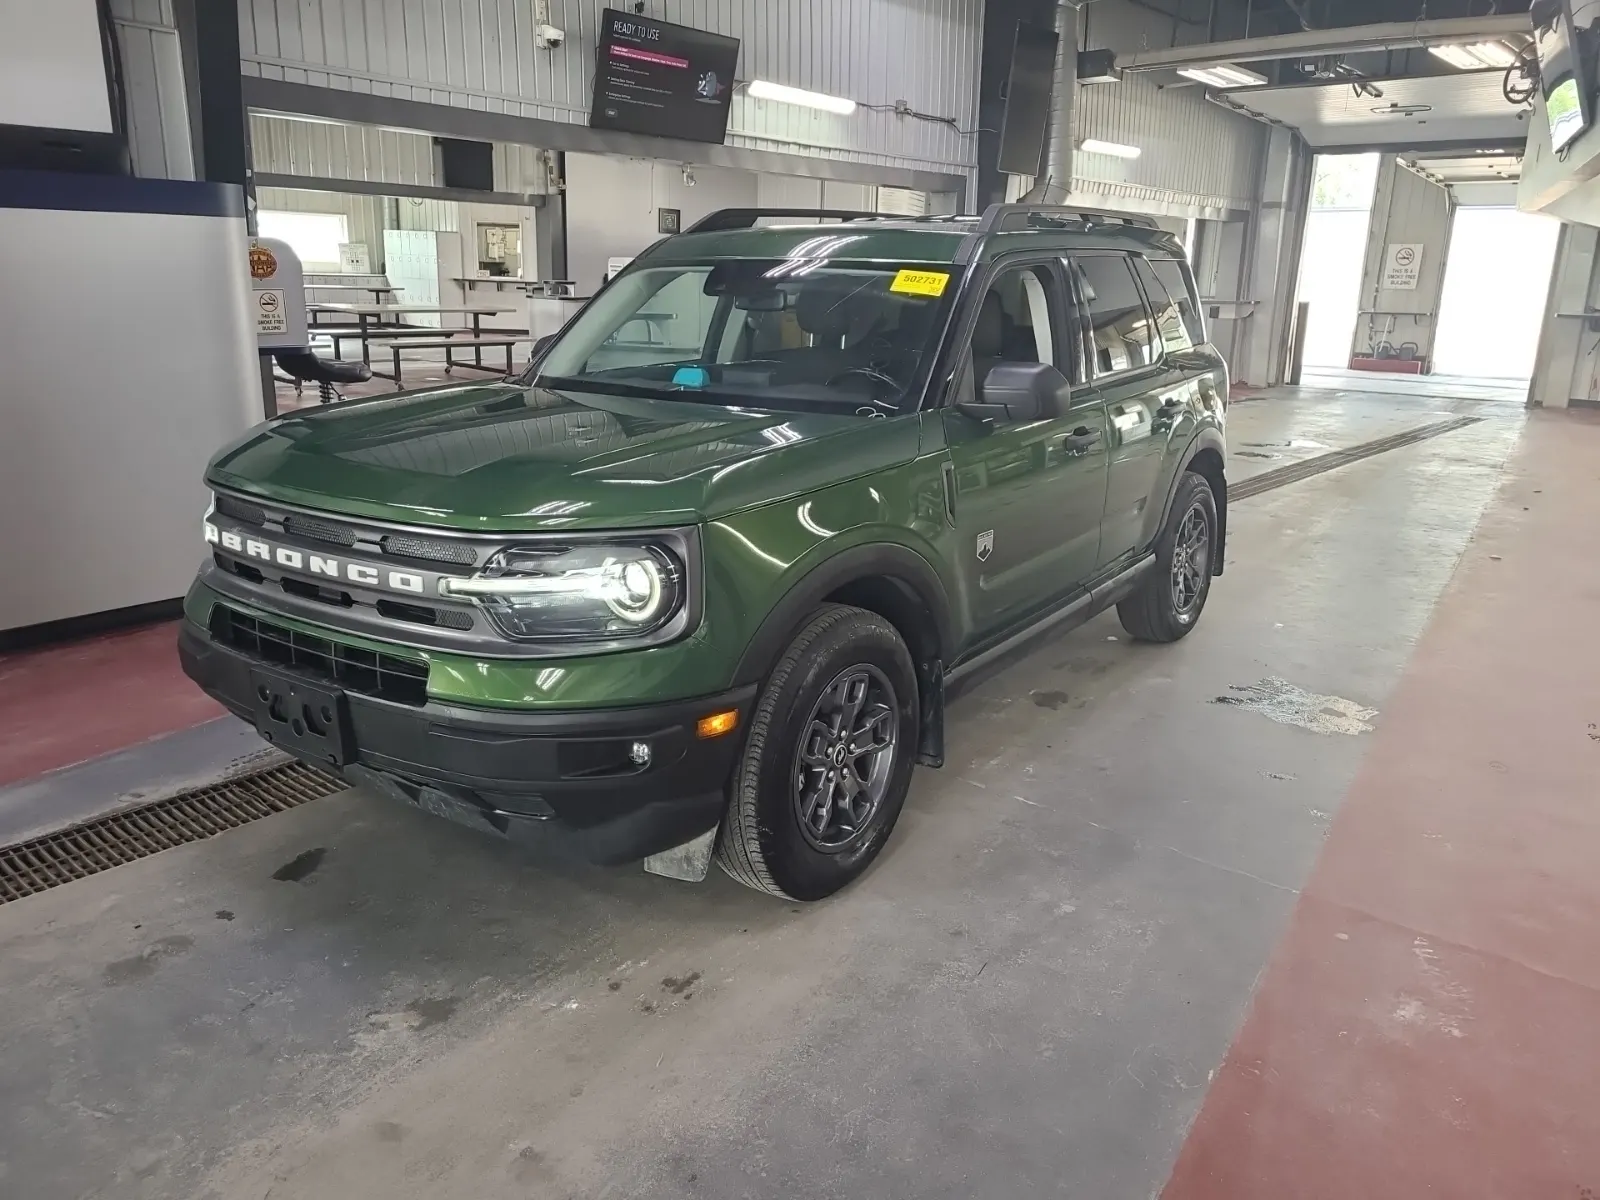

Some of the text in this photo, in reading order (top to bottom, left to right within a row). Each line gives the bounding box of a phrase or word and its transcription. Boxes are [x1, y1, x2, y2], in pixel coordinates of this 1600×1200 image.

[613, 20, 636, 35] READY
[637, 25, 646, 38] TO
[647, 29, 660, 41] USE
[903, 274, 942, 286] 502731
[221, 531, 424, 593] BRONCO
